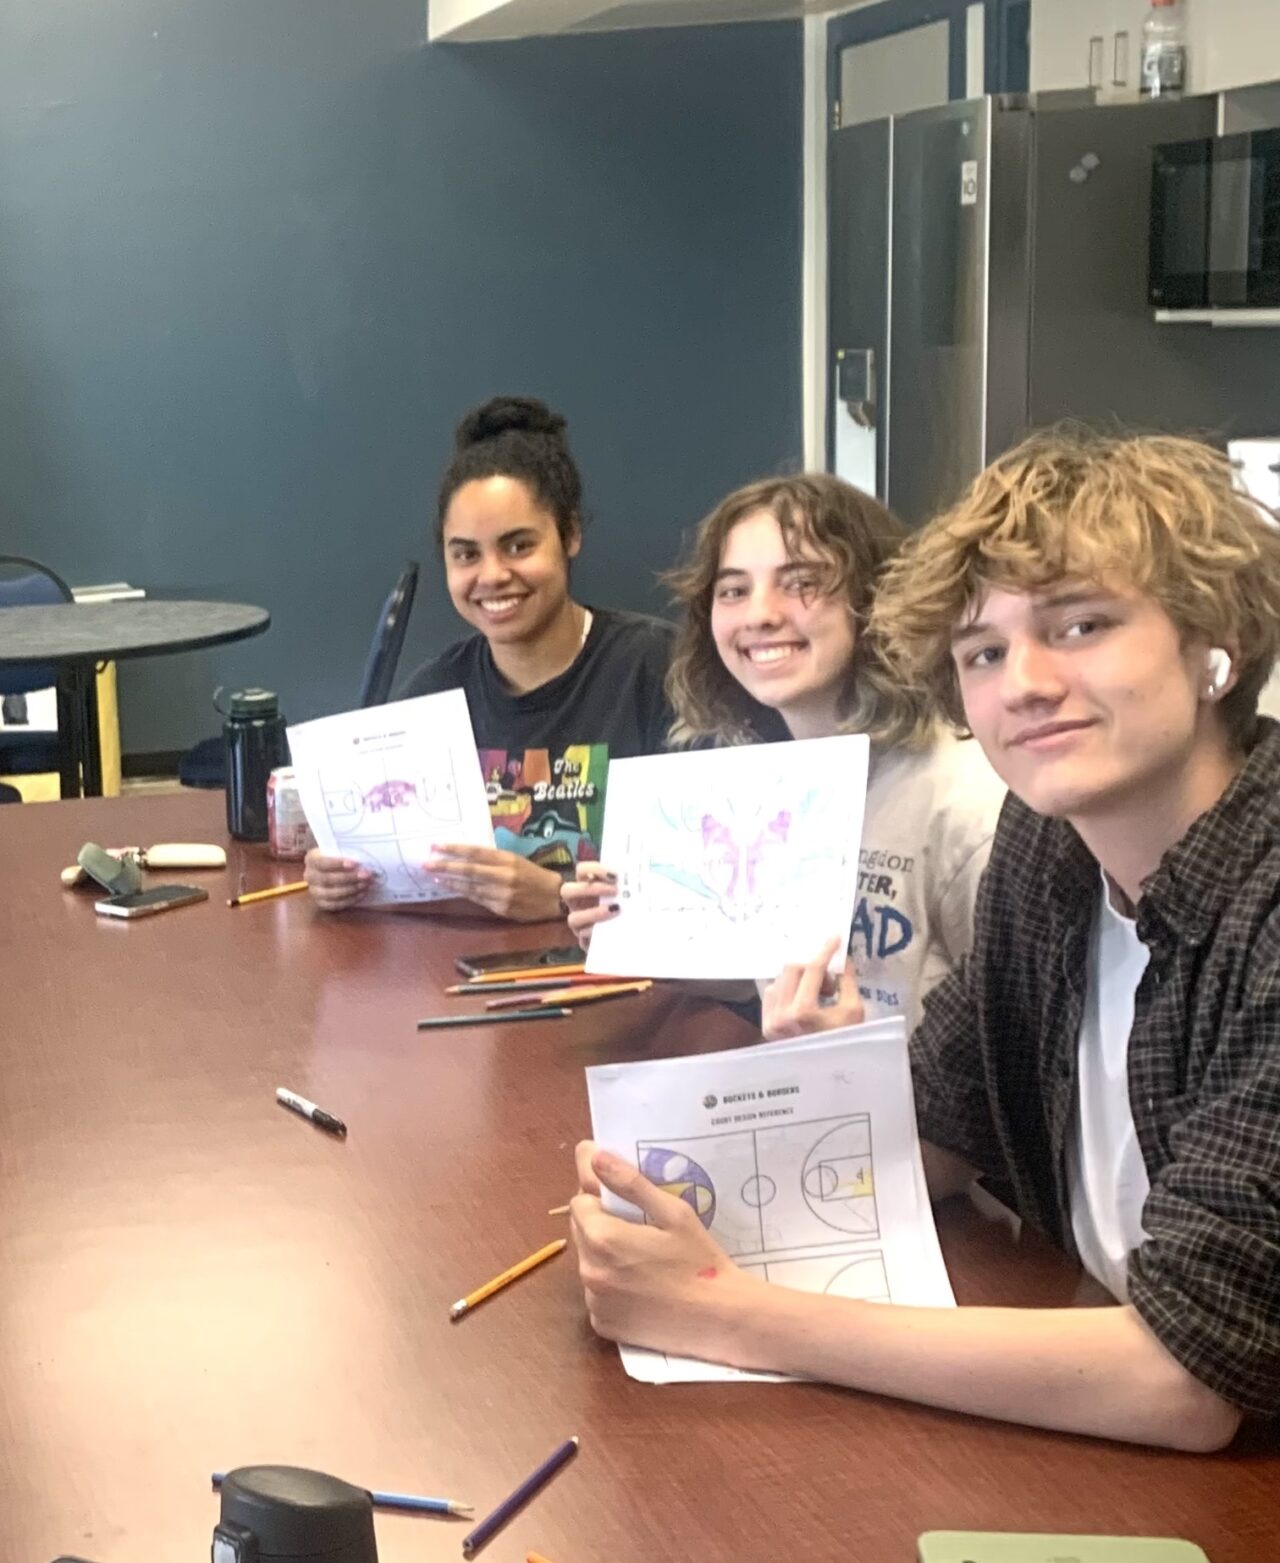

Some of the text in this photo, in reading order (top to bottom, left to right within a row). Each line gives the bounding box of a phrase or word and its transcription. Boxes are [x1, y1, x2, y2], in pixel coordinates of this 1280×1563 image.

[534, 781, 594, 801] Beatles
[847, 897, 913, 960] AD
[723, 1092, 756, 1104] BUCKETS
[767, 1086, 800, 1098] BORDERS
